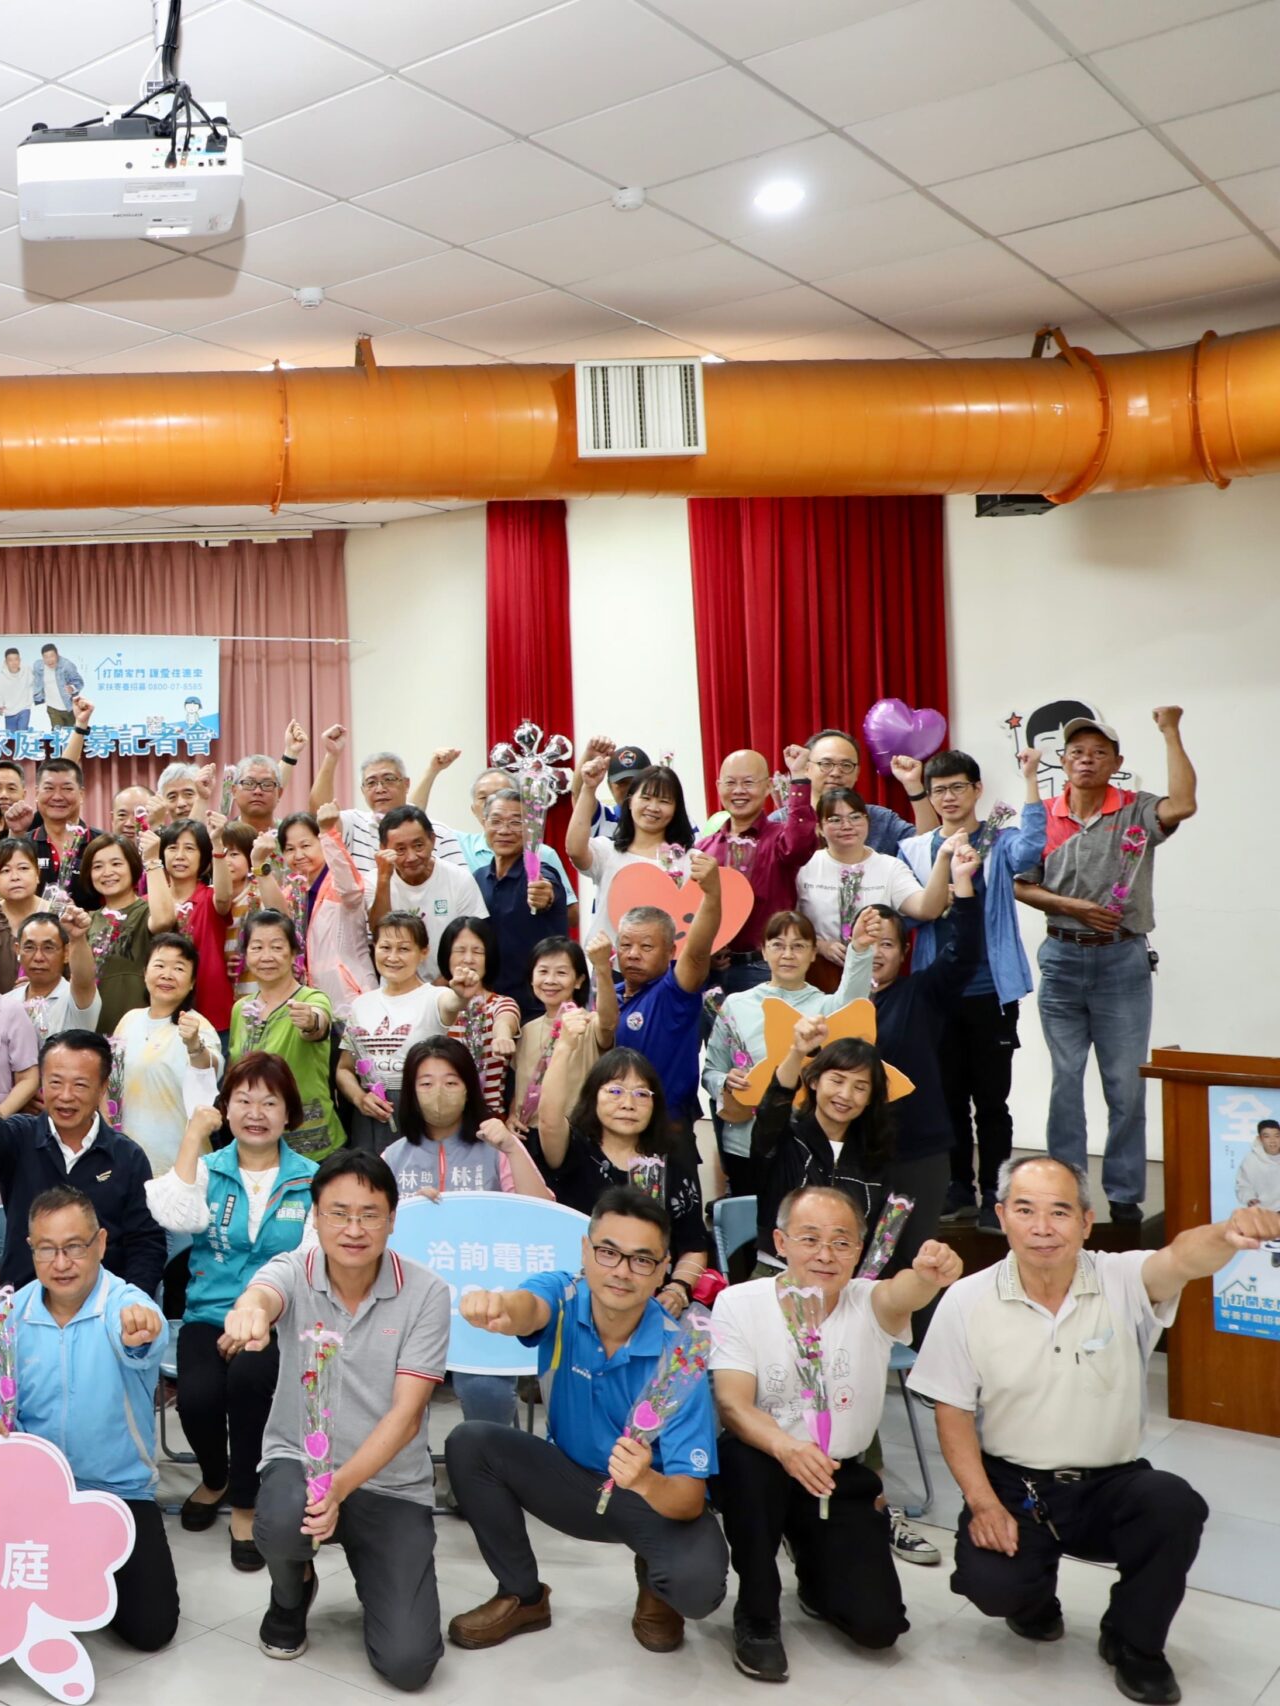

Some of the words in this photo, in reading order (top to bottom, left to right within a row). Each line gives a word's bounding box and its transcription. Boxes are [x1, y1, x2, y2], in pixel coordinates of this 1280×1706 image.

[1218, 1094, 1273, 1142] 全
[427, 1241, 556, 1273] 洽詢電話
[1230, 1294, 1280, 1311] 打開家
